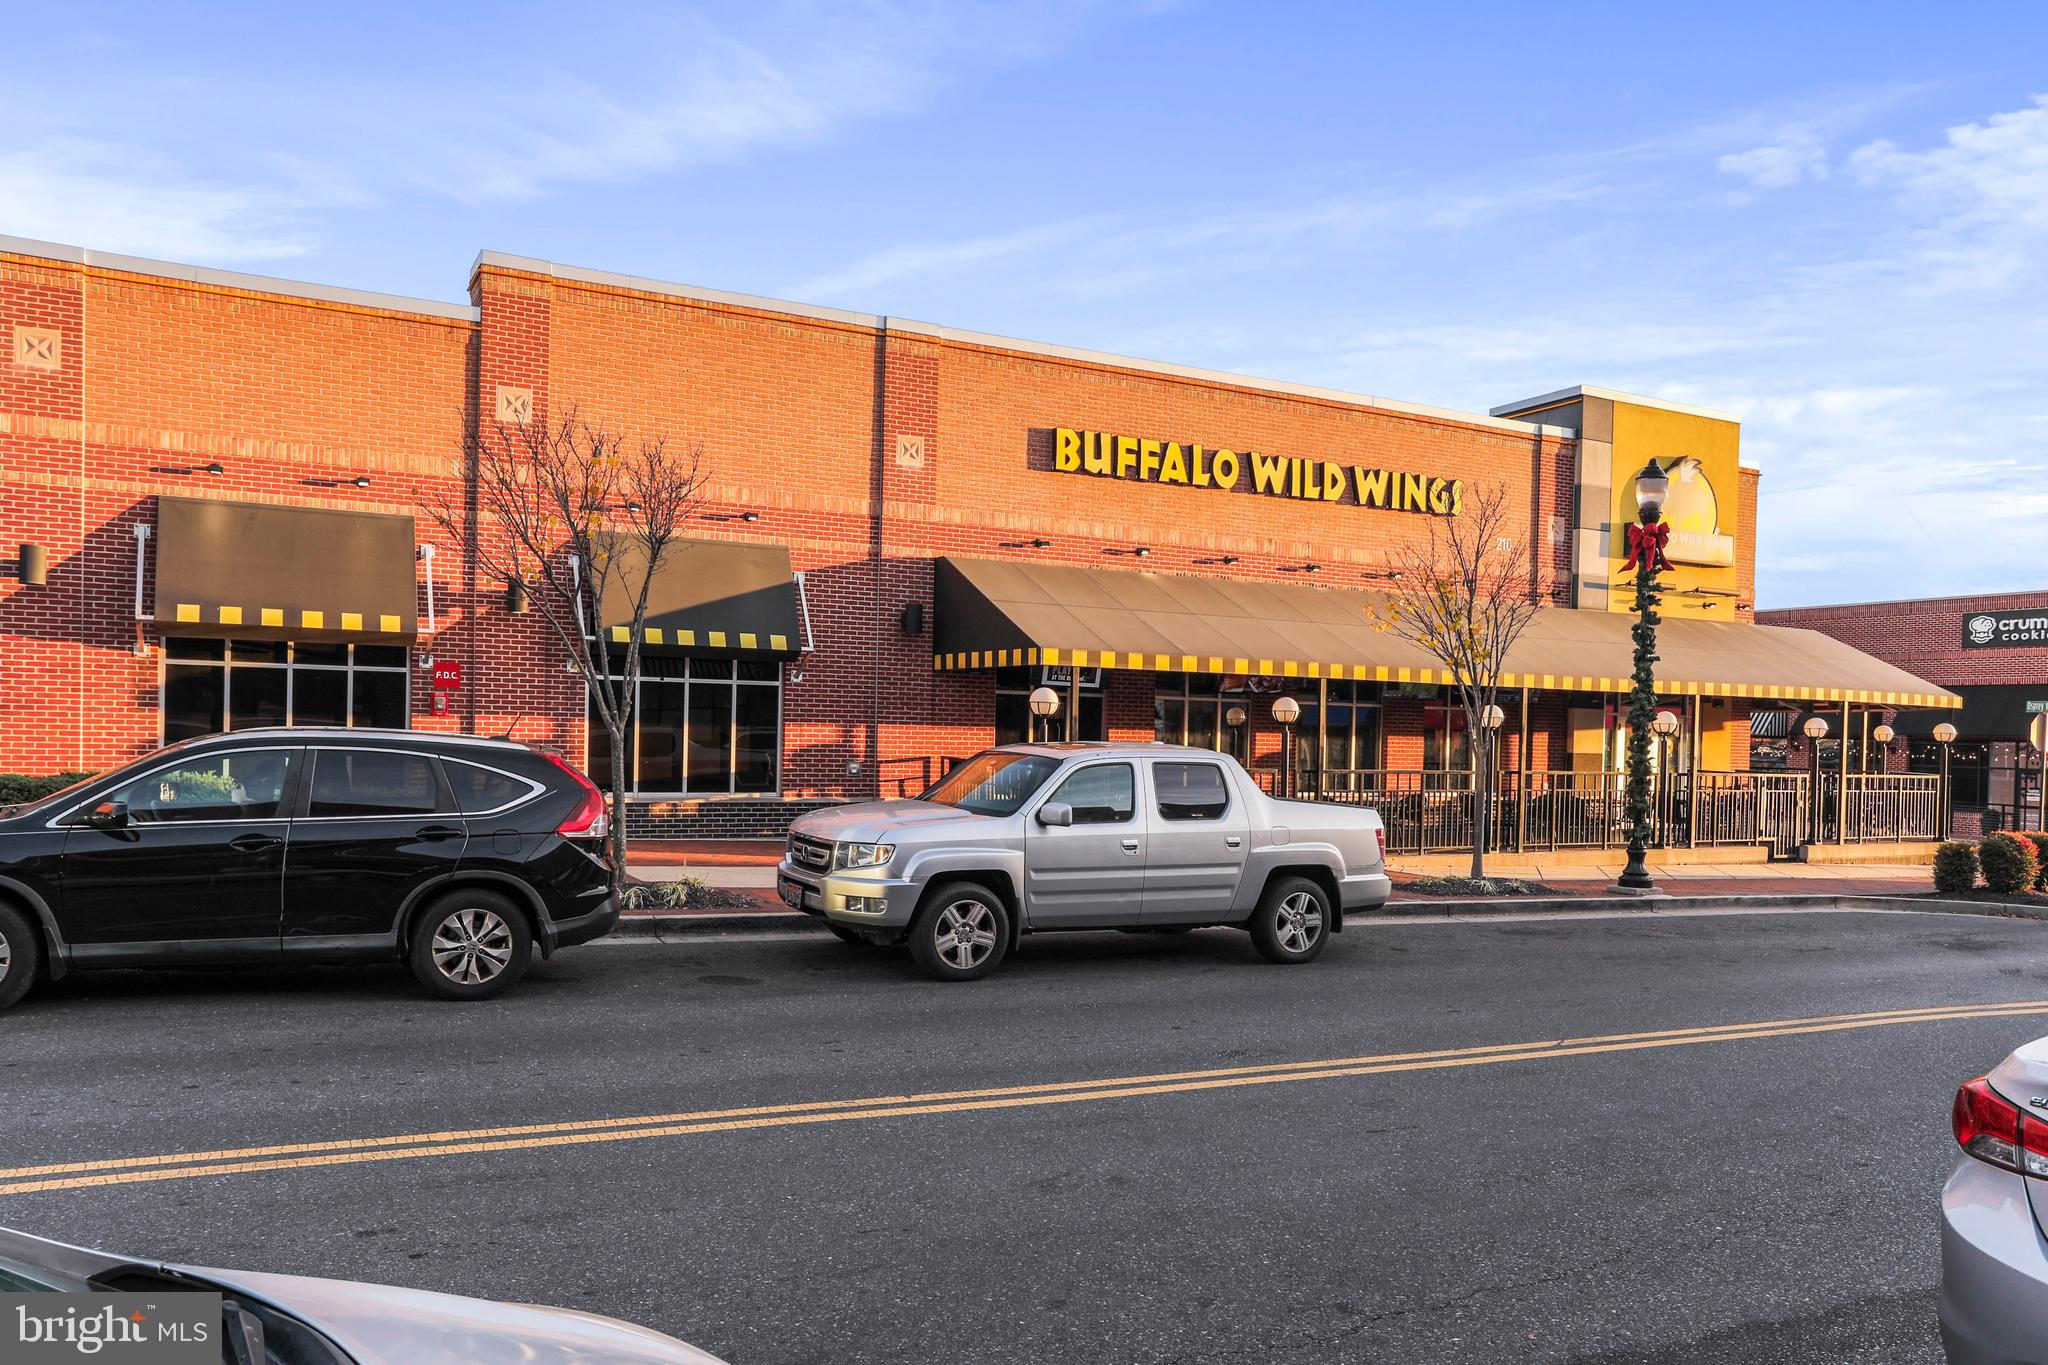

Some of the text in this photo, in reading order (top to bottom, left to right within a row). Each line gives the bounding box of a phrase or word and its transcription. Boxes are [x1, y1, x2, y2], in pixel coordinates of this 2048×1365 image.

[1054, 427, 1464, 516] BUFFALO WILD WINGS
[2002, 630, 2048, 640] cooki
